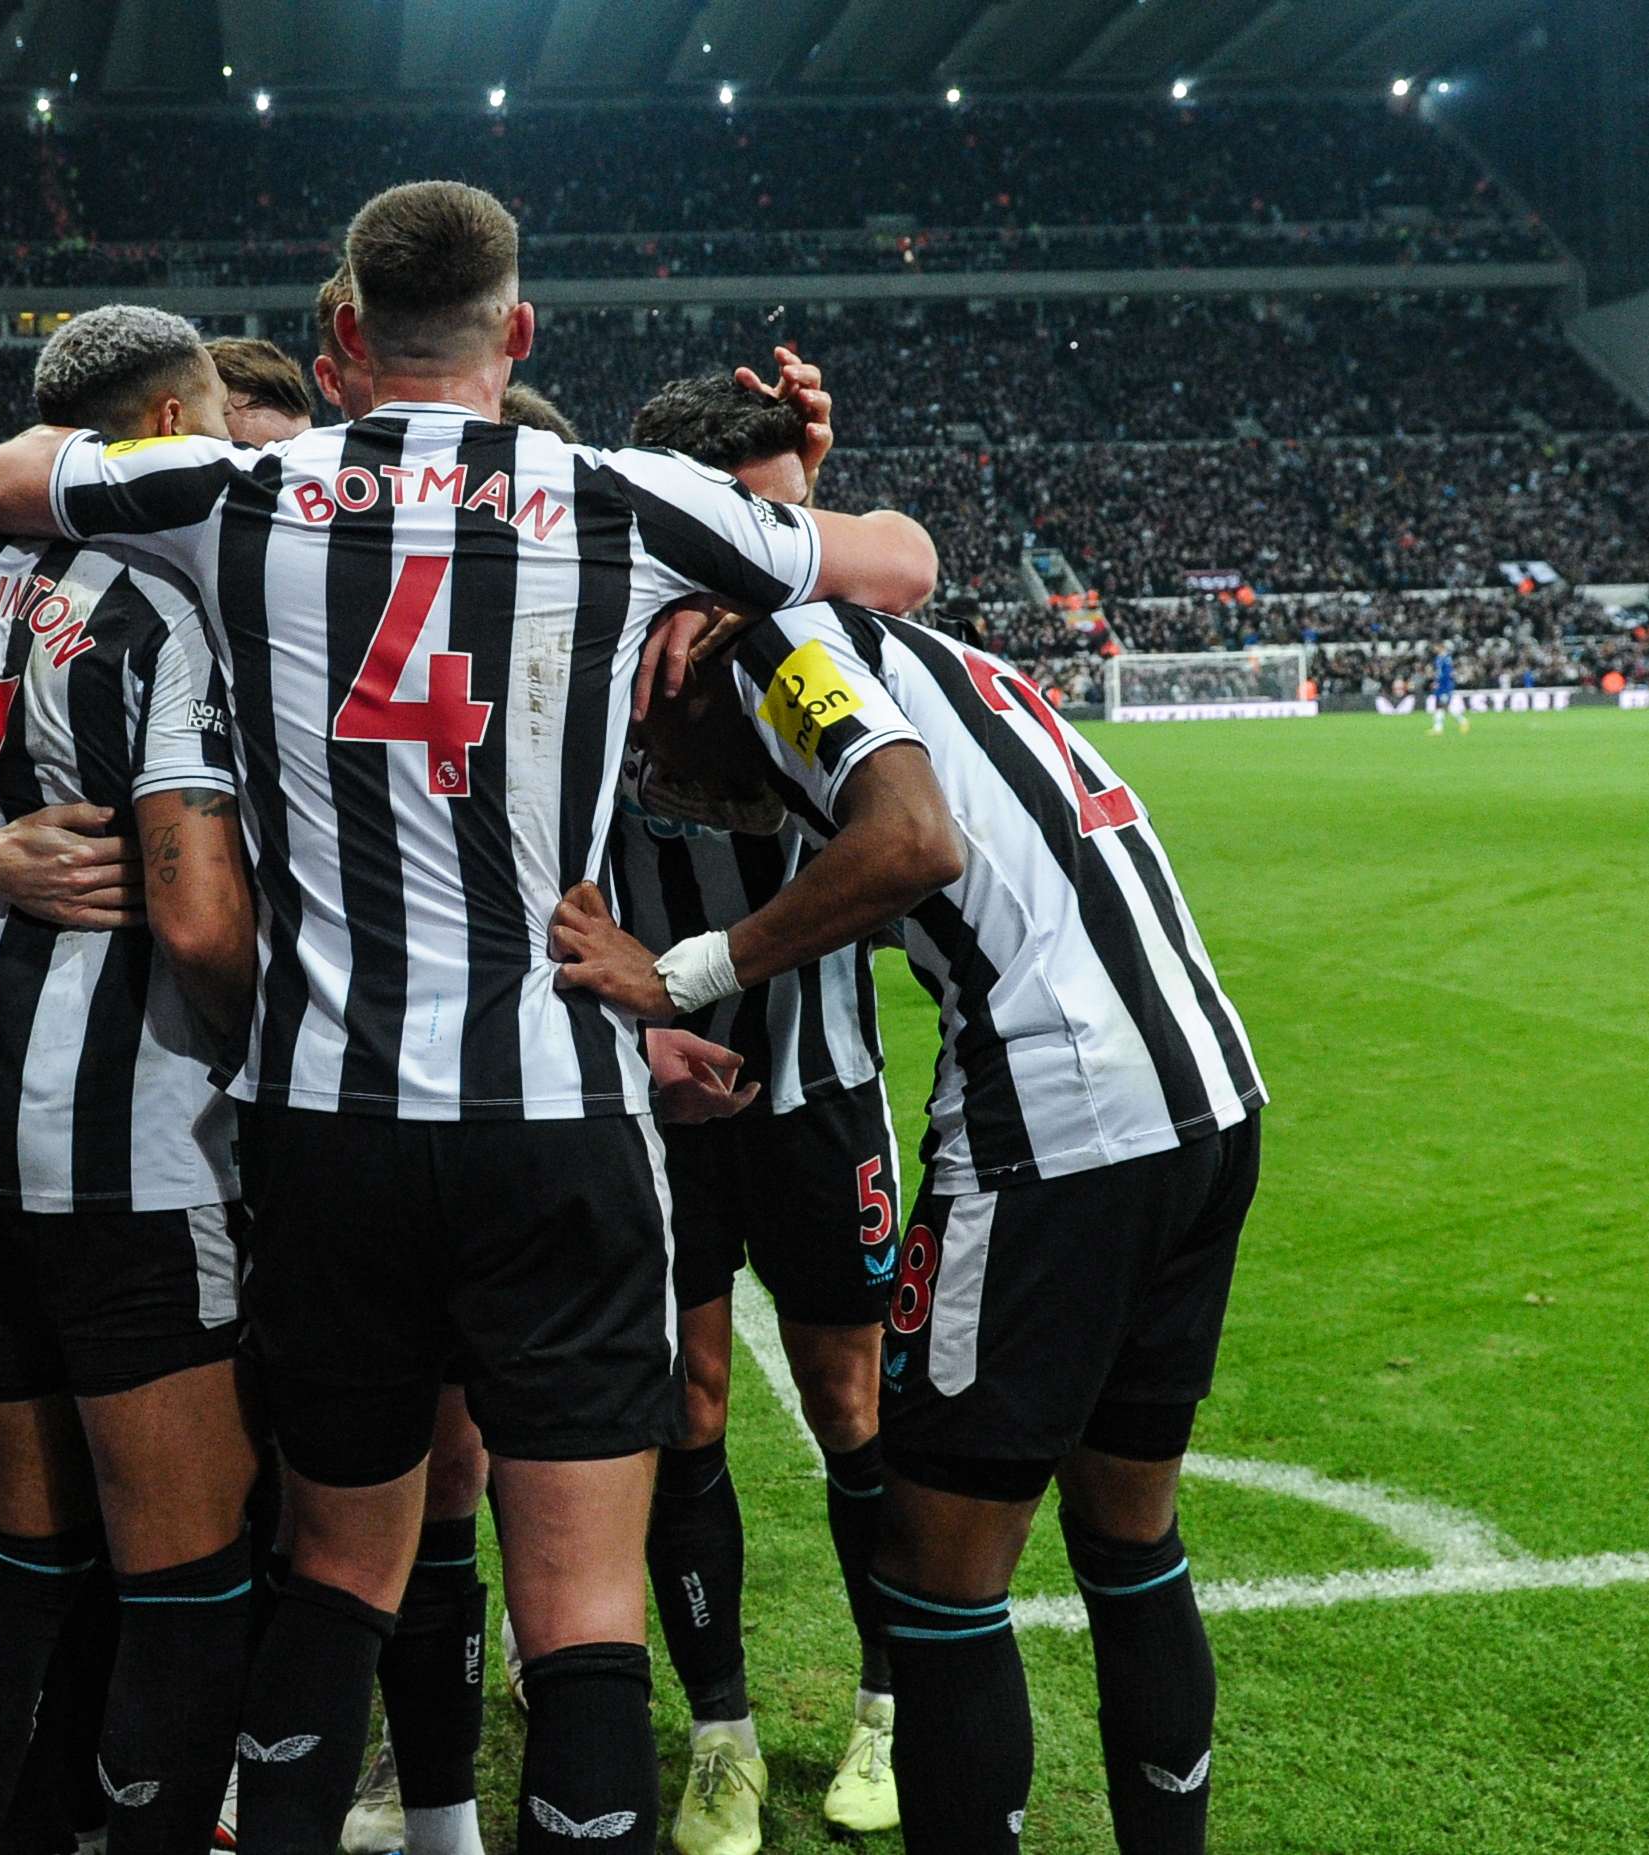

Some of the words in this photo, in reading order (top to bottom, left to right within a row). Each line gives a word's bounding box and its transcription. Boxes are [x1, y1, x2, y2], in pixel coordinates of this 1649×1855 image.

[293, 463, 567, 543] BOTMAN
[190, 700, 215, 718] No
[333, 555, 493, 797] 4
[795, 689, 850, 753] noon
[961, 647, 1140, 838] 2
[856, 1154, 892, 1246] 5
[681, 1570, 711, 1628] NUFC
[464, 1632, 481, 1685] NUFC
